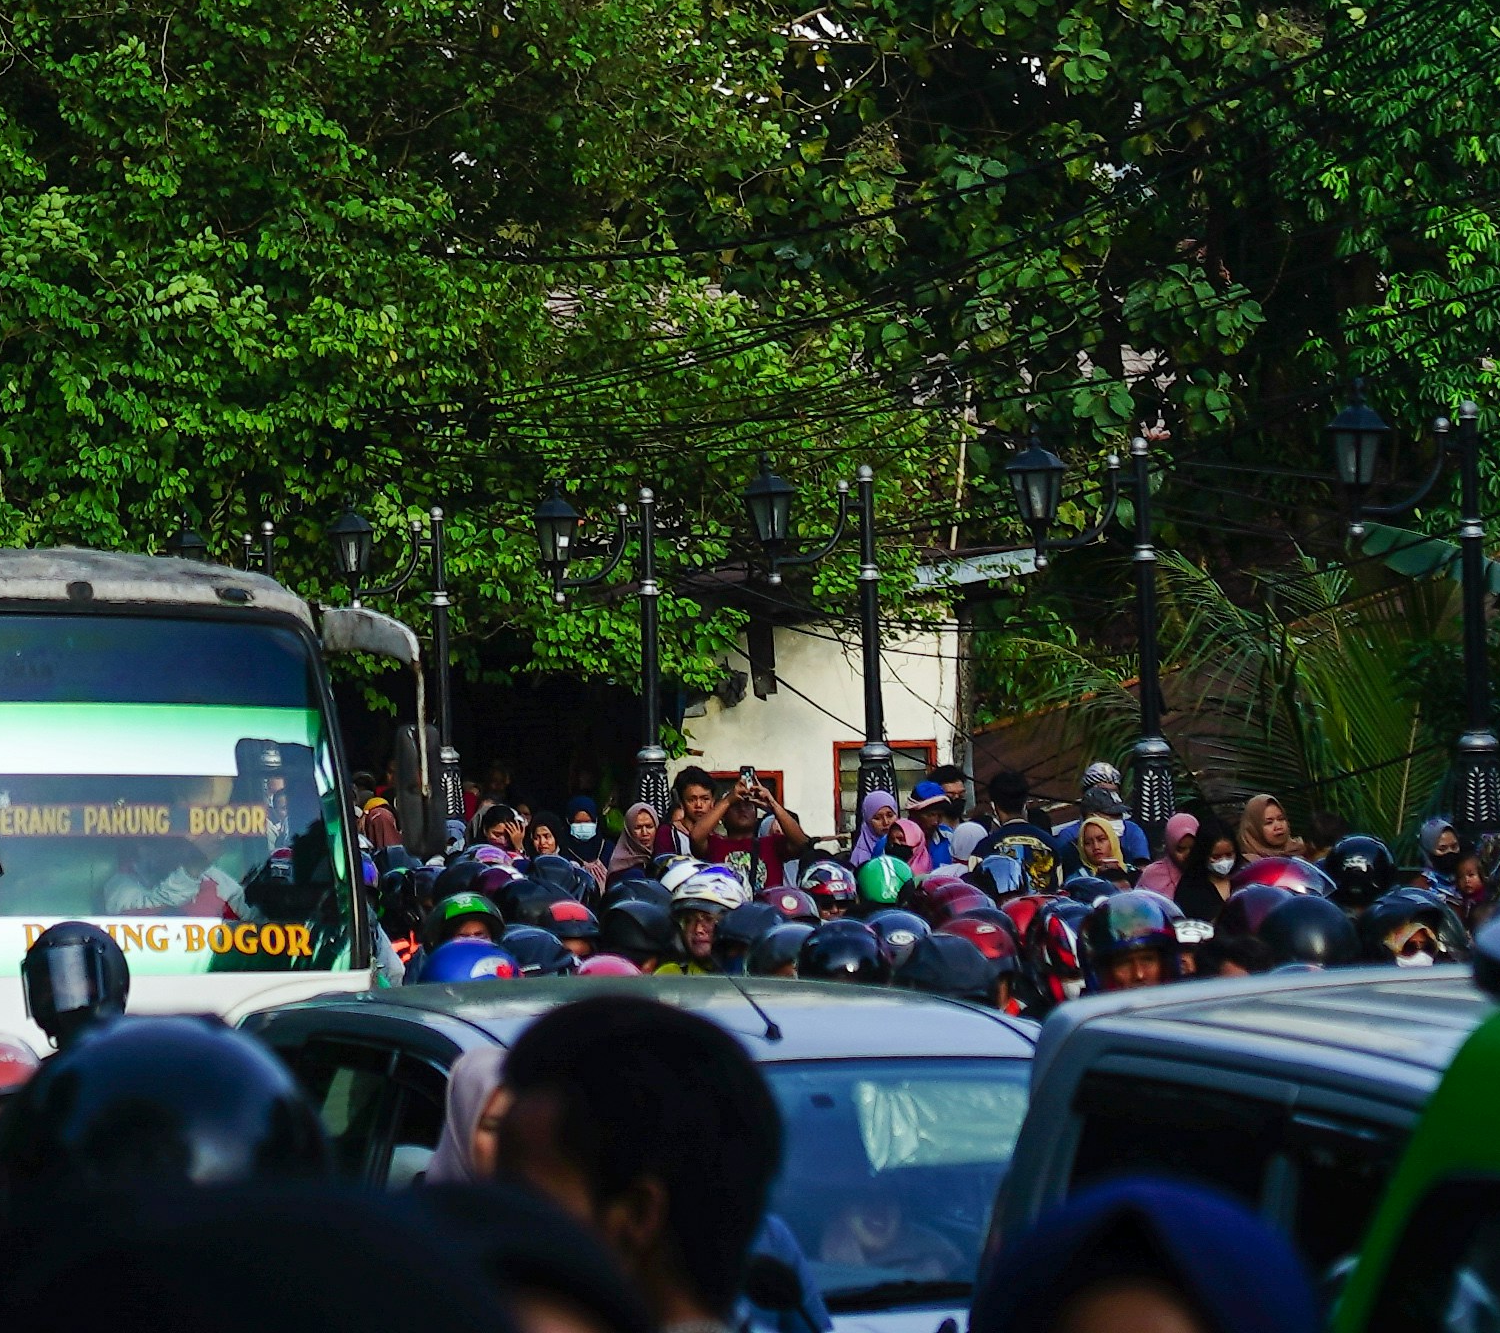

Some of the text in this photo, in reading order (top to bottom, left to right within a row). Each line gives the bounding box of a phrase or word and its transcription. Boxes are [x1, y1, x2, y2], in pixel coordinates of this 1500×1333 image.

[83, 805, 170, 834] PARUNG
[189, 805, 266, 835] BOGOR
[184, 923, 313, 958] BOGOR
